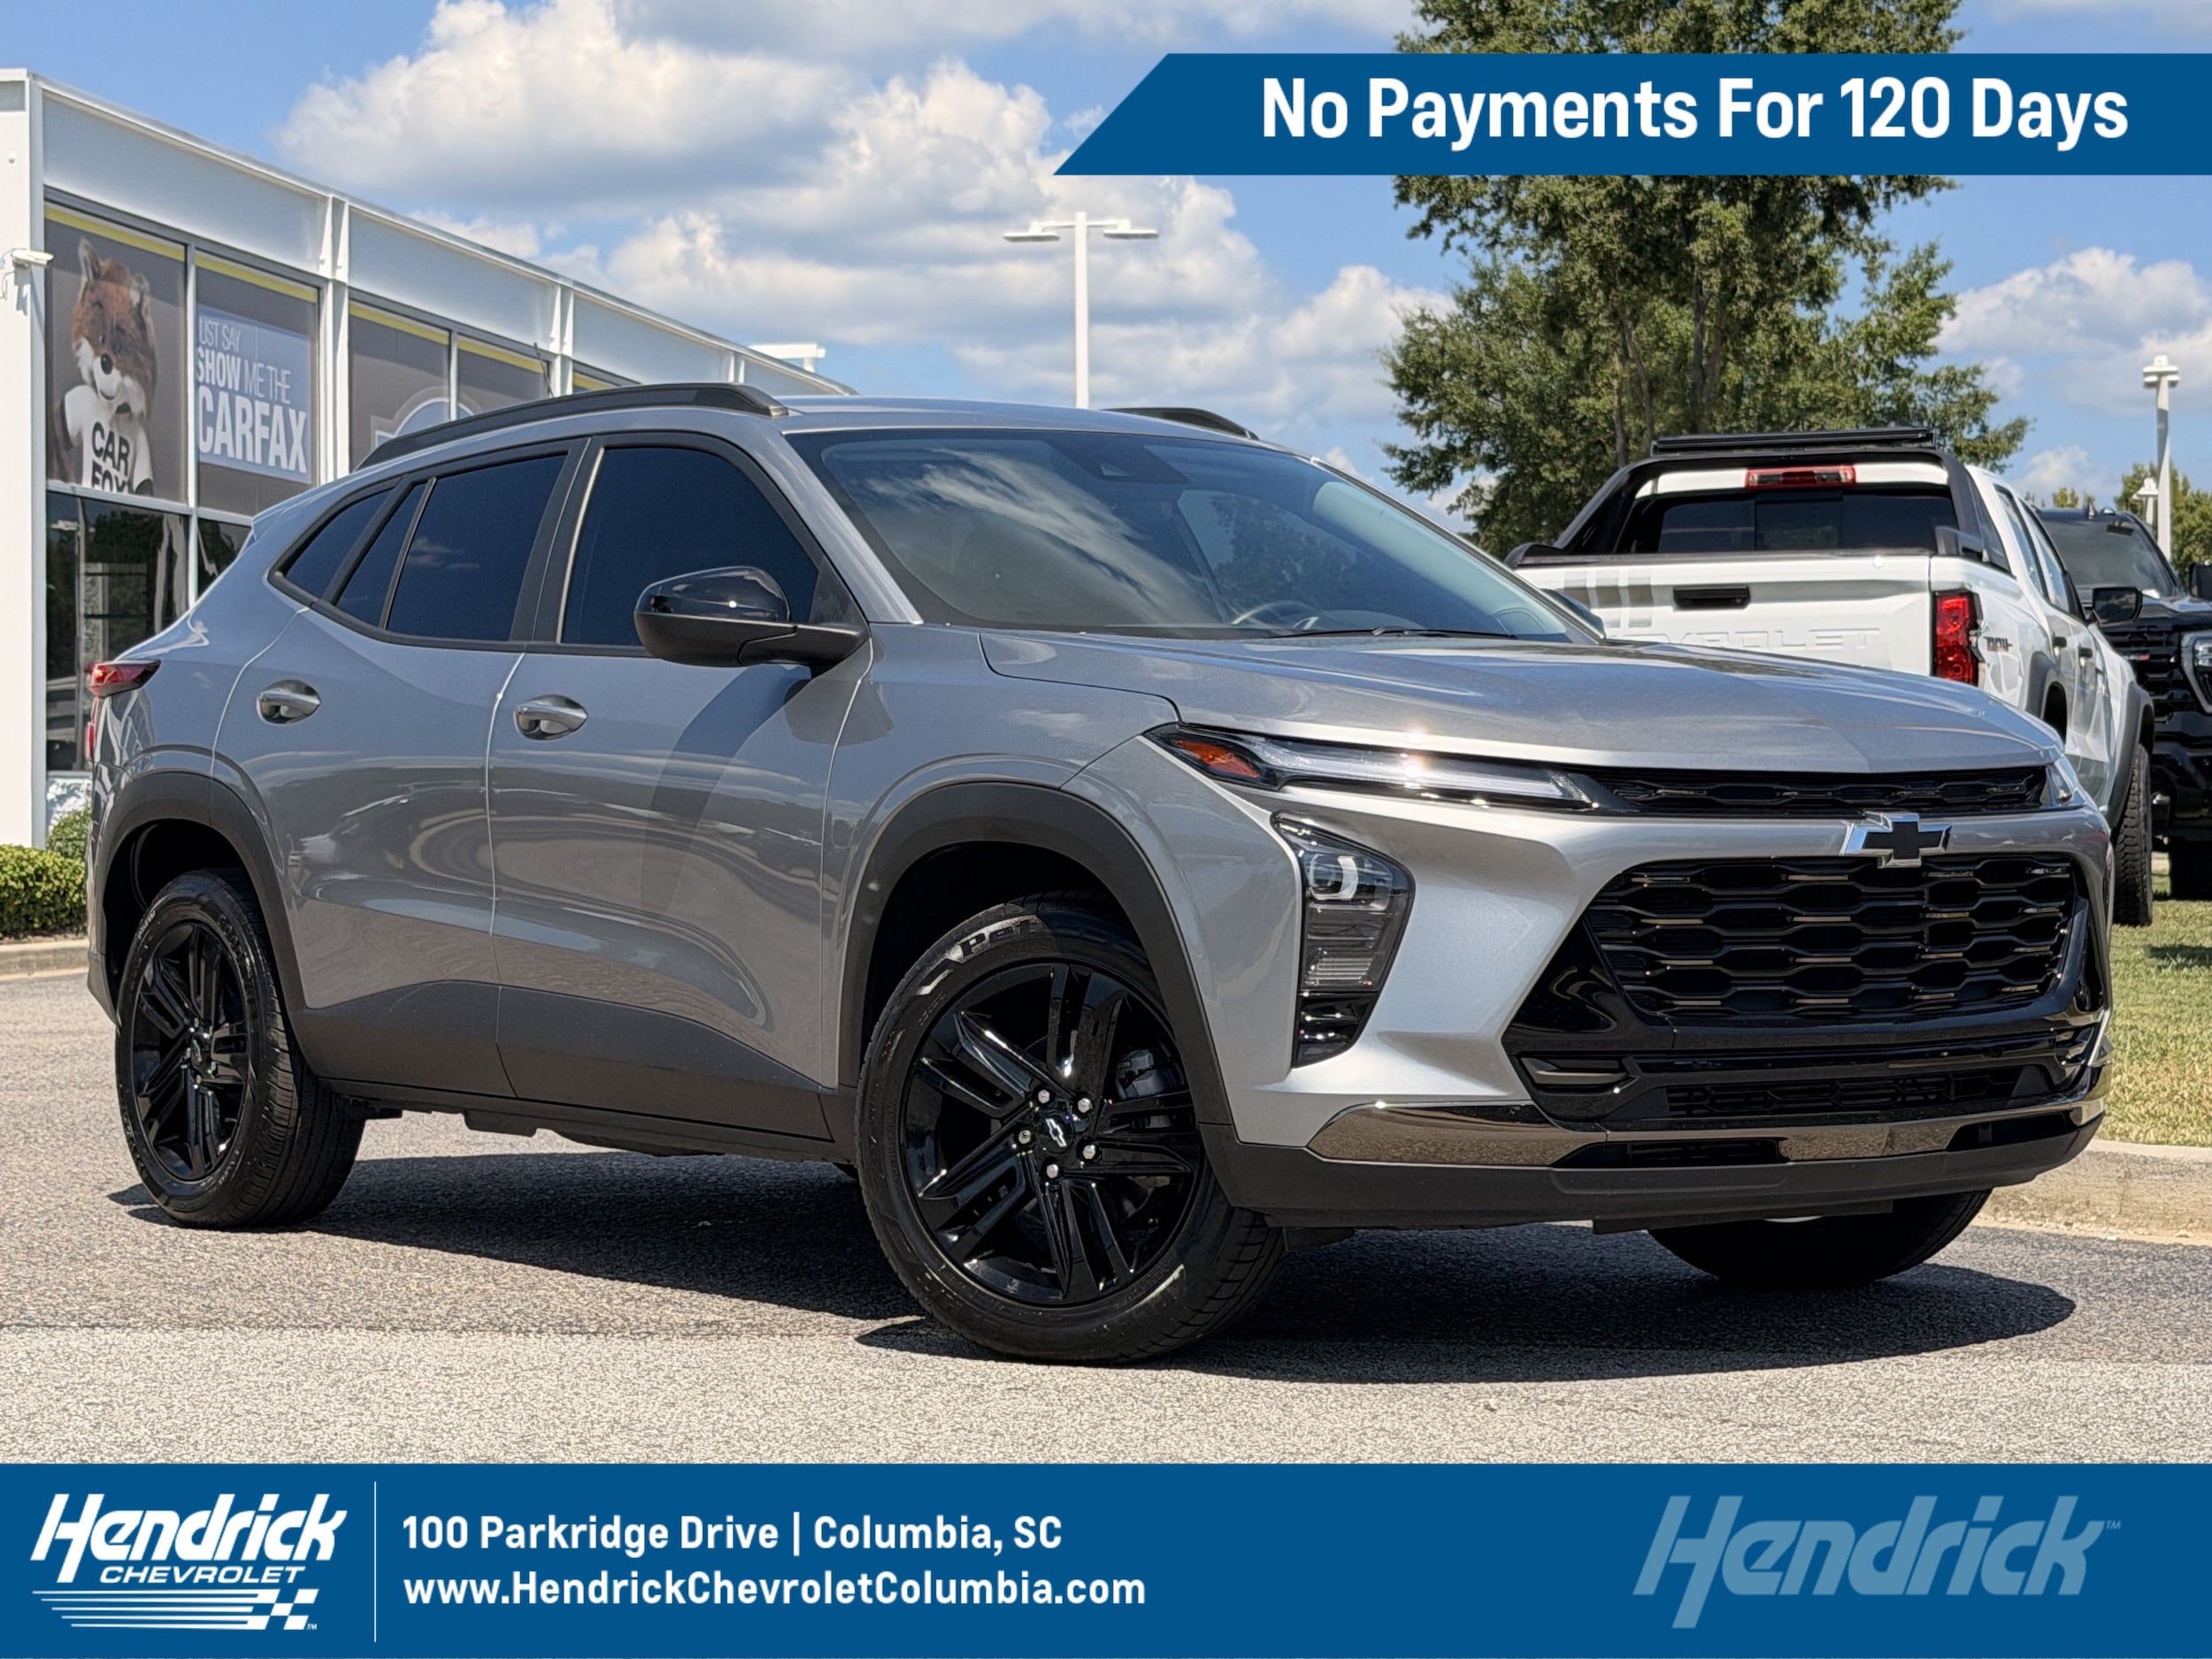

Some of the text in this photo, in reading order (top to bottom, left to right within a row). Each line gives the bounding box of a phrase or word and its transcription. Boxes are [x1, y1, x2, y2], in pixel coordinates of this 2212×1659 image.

[198, 316, 241, 354] UST SAY
[197, 346, 291, 404] SHOW ME THE
[91, 421, 130, 477] CAR
[198, 385, 307, 473] CARFAX
